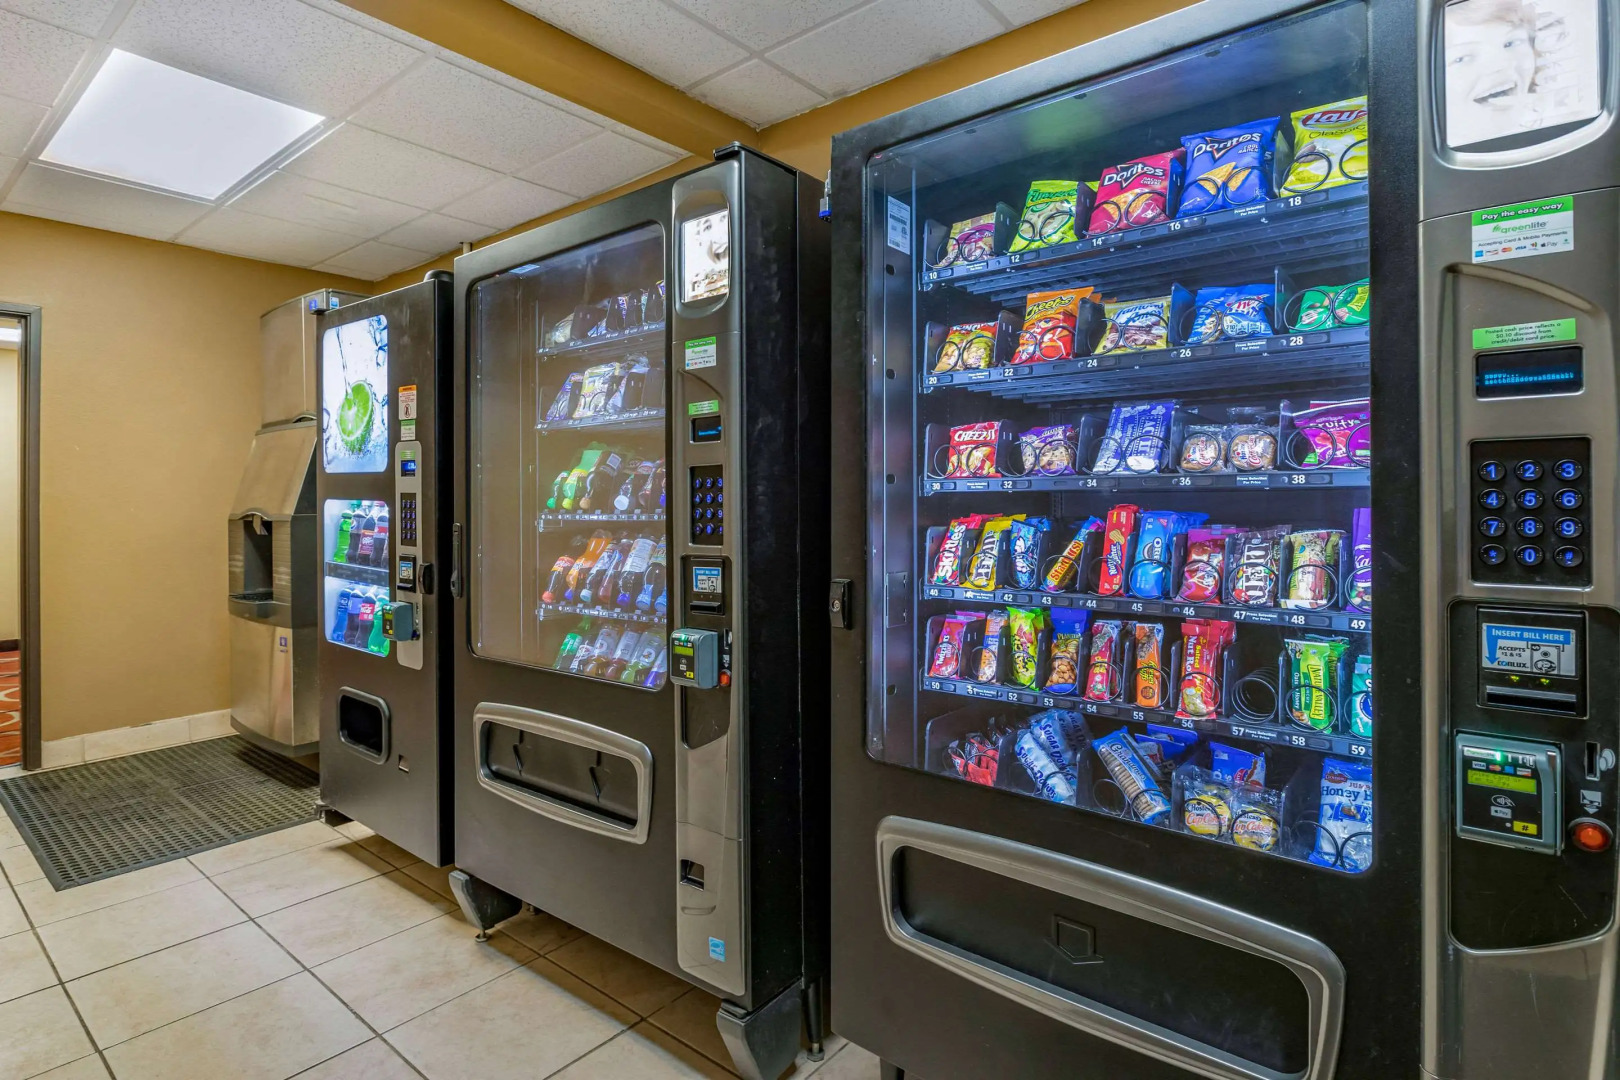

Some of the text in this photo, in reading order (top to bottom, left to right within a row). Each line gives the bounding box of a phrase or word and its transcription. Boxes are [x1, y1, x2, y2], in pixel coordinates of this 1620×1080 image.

[1193, 133, 1263, 158] Doritos
[1103, 163, 1164, 188] Doritos
[1288, 196, 1302, 206] 18
[1481, 201, 1564, 221] Pay the easy way
[1169, 221, 1181, 231] 16
[1500, 221, 1547, 234] greenlite
[1092, 238, 1102, 246] 14
[1011, 254, 1020, 263] 12
[929, 271, 938, 279] 10
[1289, 336, 1304, 346] 28
[1179, 349, 1192, 358] 26
[1087, 359, 1098, 368] 24
[1004, 368, 1014, 376] 22
[928, 377, 937, 385] 20
[1487, 463, 1575, 478] 1 2 3
[1086, 478, 1097, 487] 34
[1179, 477, 1191, 486] 36
[1291, 475, 1306, 484] 38
[932, 482, 941, 490] 30
[1003, 480, 1013, 489] 32
[1486, 492, 1575, 506] 4 5 6
[1487, 520, 1575, 535] 7 8 9
[1523, 548, 1536, 562] 0
[929, 589, 938, 597] 40
[1003, 593, 1013, 602] 42
[1041, 597, 1052, 605] 43
[1086, 600, 1097, 608] 44
[1131, 603, 1143, 612] 45
[1182, 606, 1195, 616] 46
[1233, 610, 1246, 620] 47
[1290, 615, 1305, 624] 48
[1350, 620, 1366, 629] 49
[1492, 628, 1564, 641] INSERT BILL HERE
[931, 682, 940, 690] 50
[1008, 692, 1018, 701] 52
[1044, 698, 1054, 706] 53
[1086, 705, 1098, 713] 54
[1133, 711, 1144, 720] 55
[1181, 719, 1193, 728] 56
[1231, 727, 1245, 736] 57
[1039, 723, 1059, 750] SUGAR
[1291, 736, 1306, 746] 58
[1351, 746, 1366, 755] 59
[1016, 746, 1057, 799] SUGAR DONUTS
[1321, 786, 1360, 802] Honey
